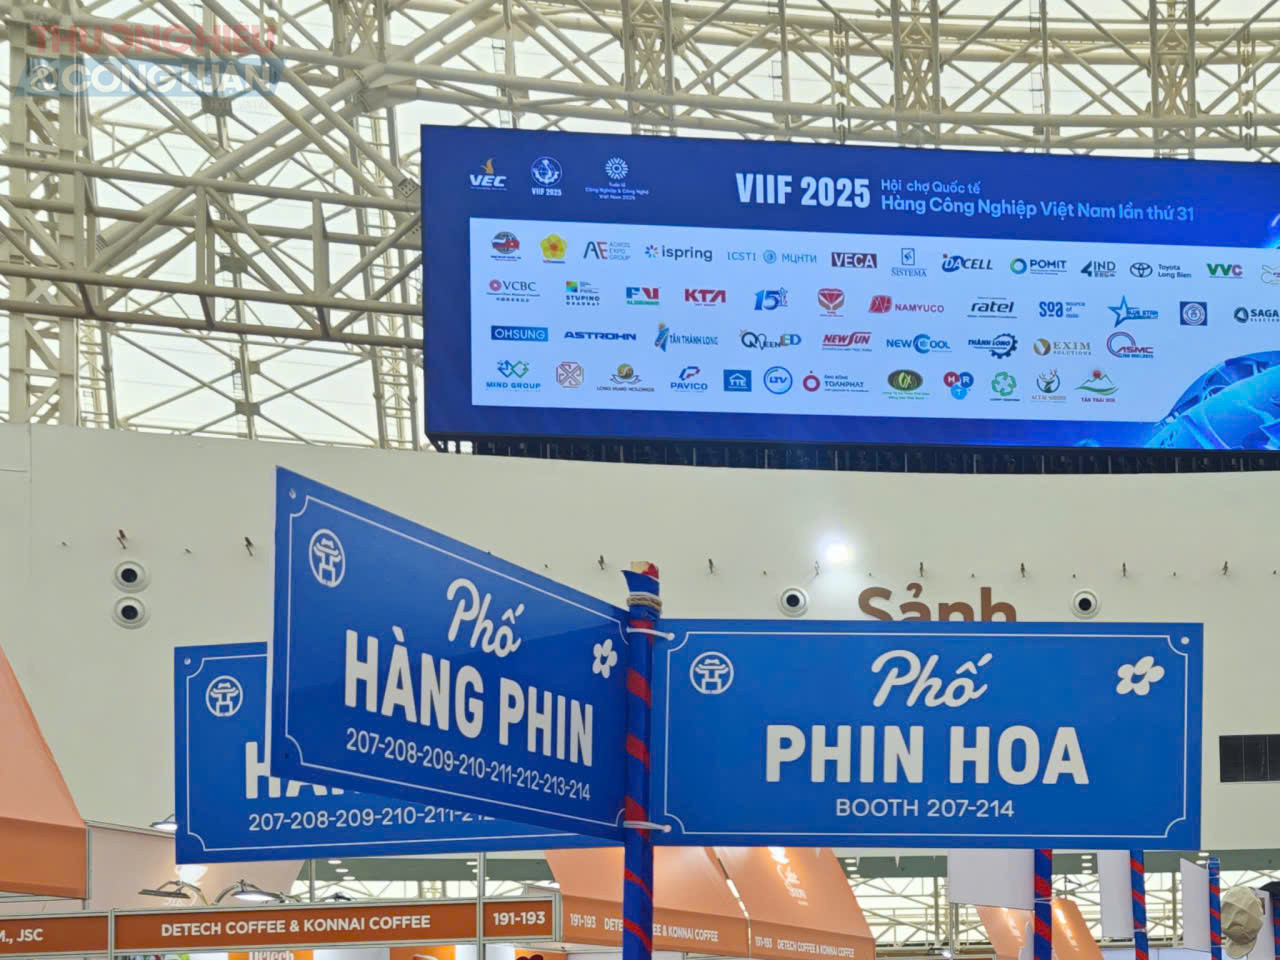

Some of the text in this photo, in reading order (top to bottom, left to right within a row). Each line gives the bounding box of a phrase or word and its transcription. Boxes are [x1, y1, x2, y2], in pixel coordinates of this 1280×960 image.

[470, 174, 508, 187] VEC
[881, 178, 981, 195] Hội chợ Quốc tế
[735, 173, 870, 208] VIIF 2025
[881, 193, 1194, 221] Hàng Công Nghiệp Việt Nam lần thứ 31
[661, 245, 713, 262] ispring
[832, 253, 875, 268] VECA
[1030, 259, 1067, 269] POMIT
[1158, 264, 1181, 272] Toyota
[1206, 263, 1243, 275] VVC
[502, 280, 537, 291] VCBC
[895, 303, 945, 313] NAMYUCO
[970, 301, 1014, 313] ratel
[1250, 309, 1279, 318] SAGA
[494, 328, 546, 340] OHSUNG
[445, 577, 525, 658] Phố
[871, 649, 993, 707] Phố
[345, 625, 594, 767] HÀNG PHIN
[766, 724, 1090, 785] PHIN HOA
[346, 727, 591, 801] 207-208-209-210-211-212-213-214
[835, 799, 1015, 818] BOOTH 207-214
[161, 915, 431, 937] DETECH COFFEE & KONNAI COFFEE
[493, 911, 546, 926] 191-193
[16, 928, 44, 942] JSC
[569, 913, 597, 929] 191-193
[604, 917, 624, 932] DETE
[694, 929, 719, 942] COFFEE
